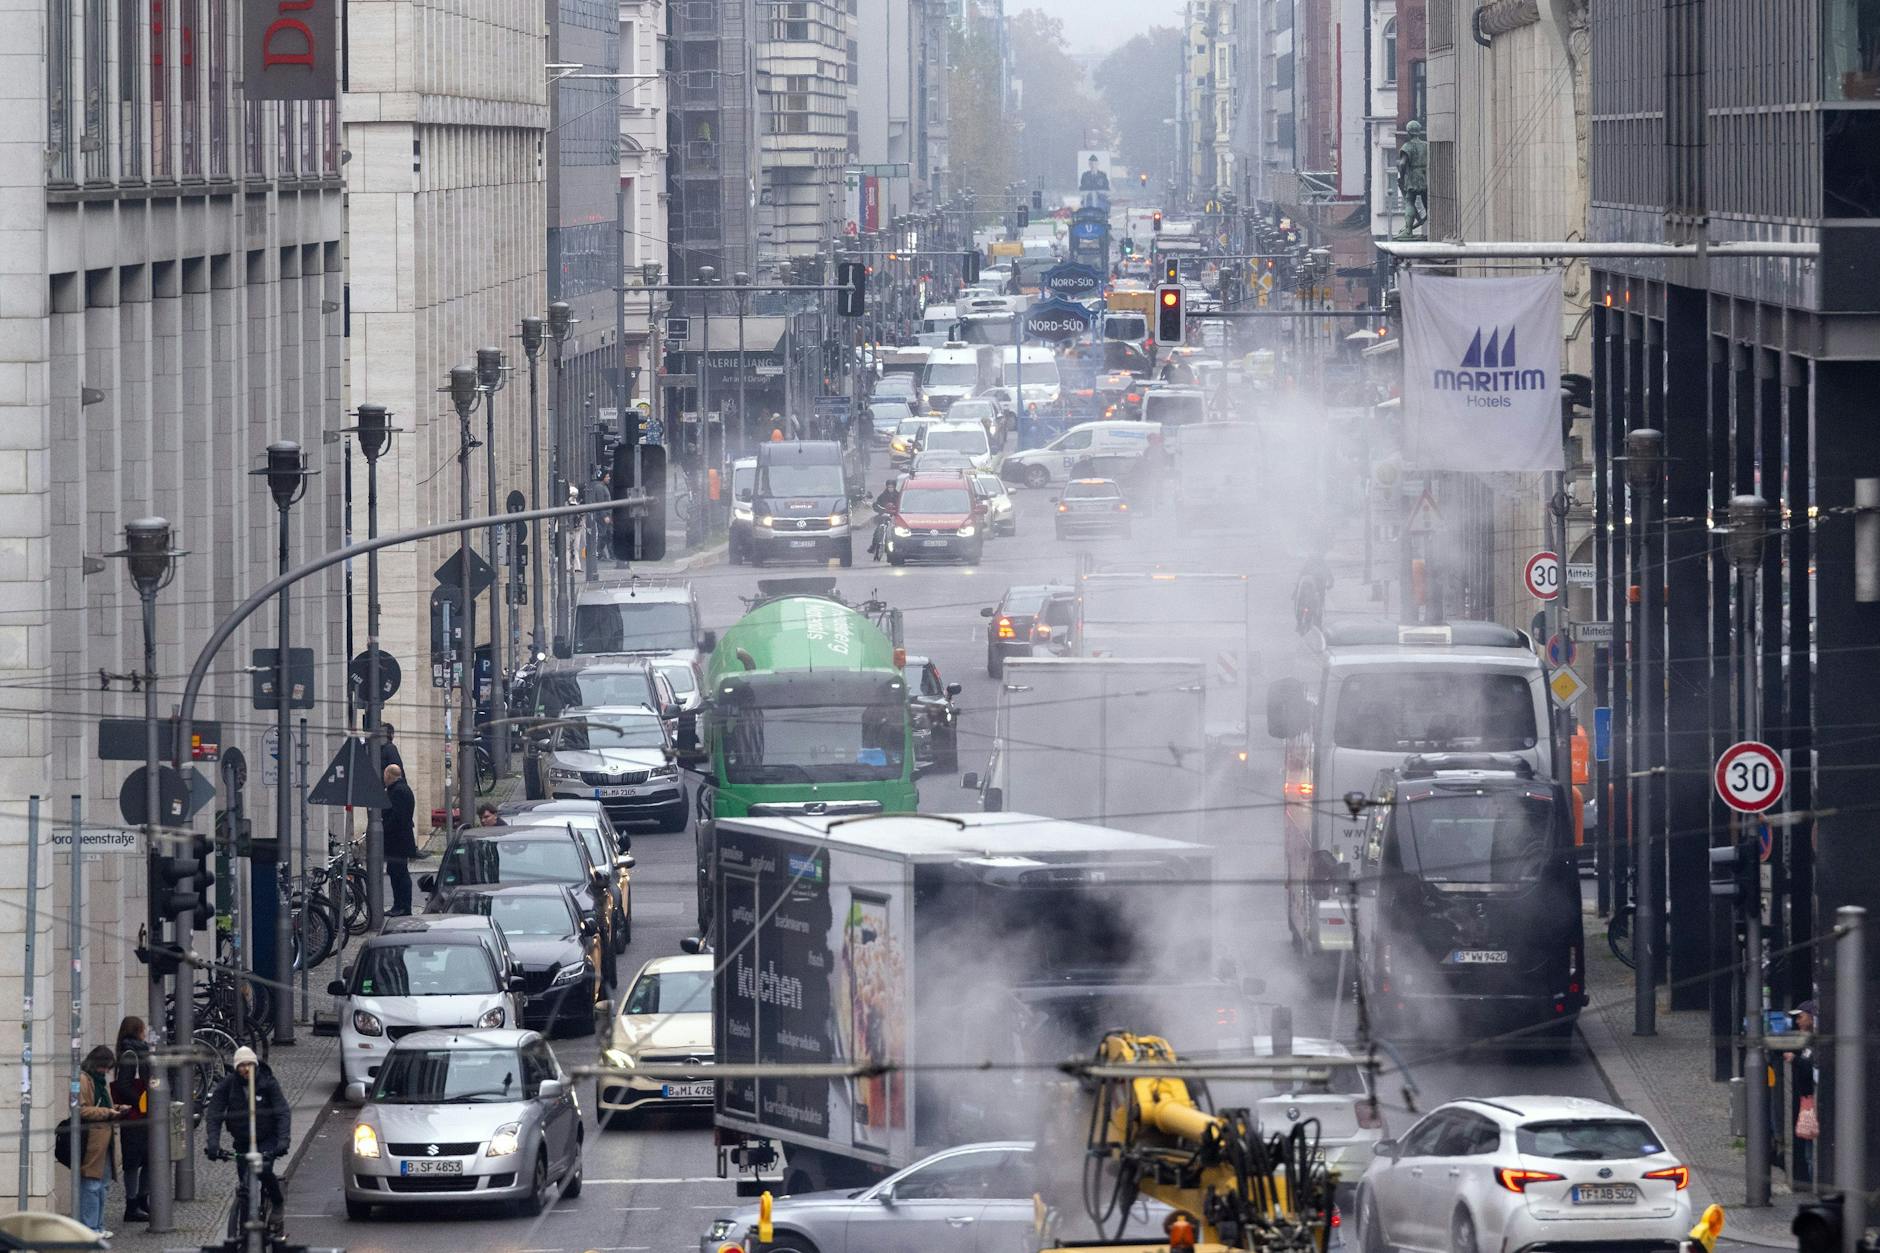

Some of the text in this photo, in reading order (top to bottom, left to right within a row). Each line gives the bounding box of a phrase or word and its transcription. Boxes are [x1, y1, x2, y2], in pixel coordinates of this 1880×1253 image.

[1050, 277, 1094, 287] NORD-SÜD
[1028, 318, 1084, 332] NORD-SÜD
[1433, 368, 1546, 392] MARITIM
[1466, 395, 1512, 408] Hotels
[1534, 565, 1558, 587] 30
[1731, 762, 1770, 792] 30
[435, 1161, 461, 1173] 4853
[1615, 1188, 1634, 1200] 502
